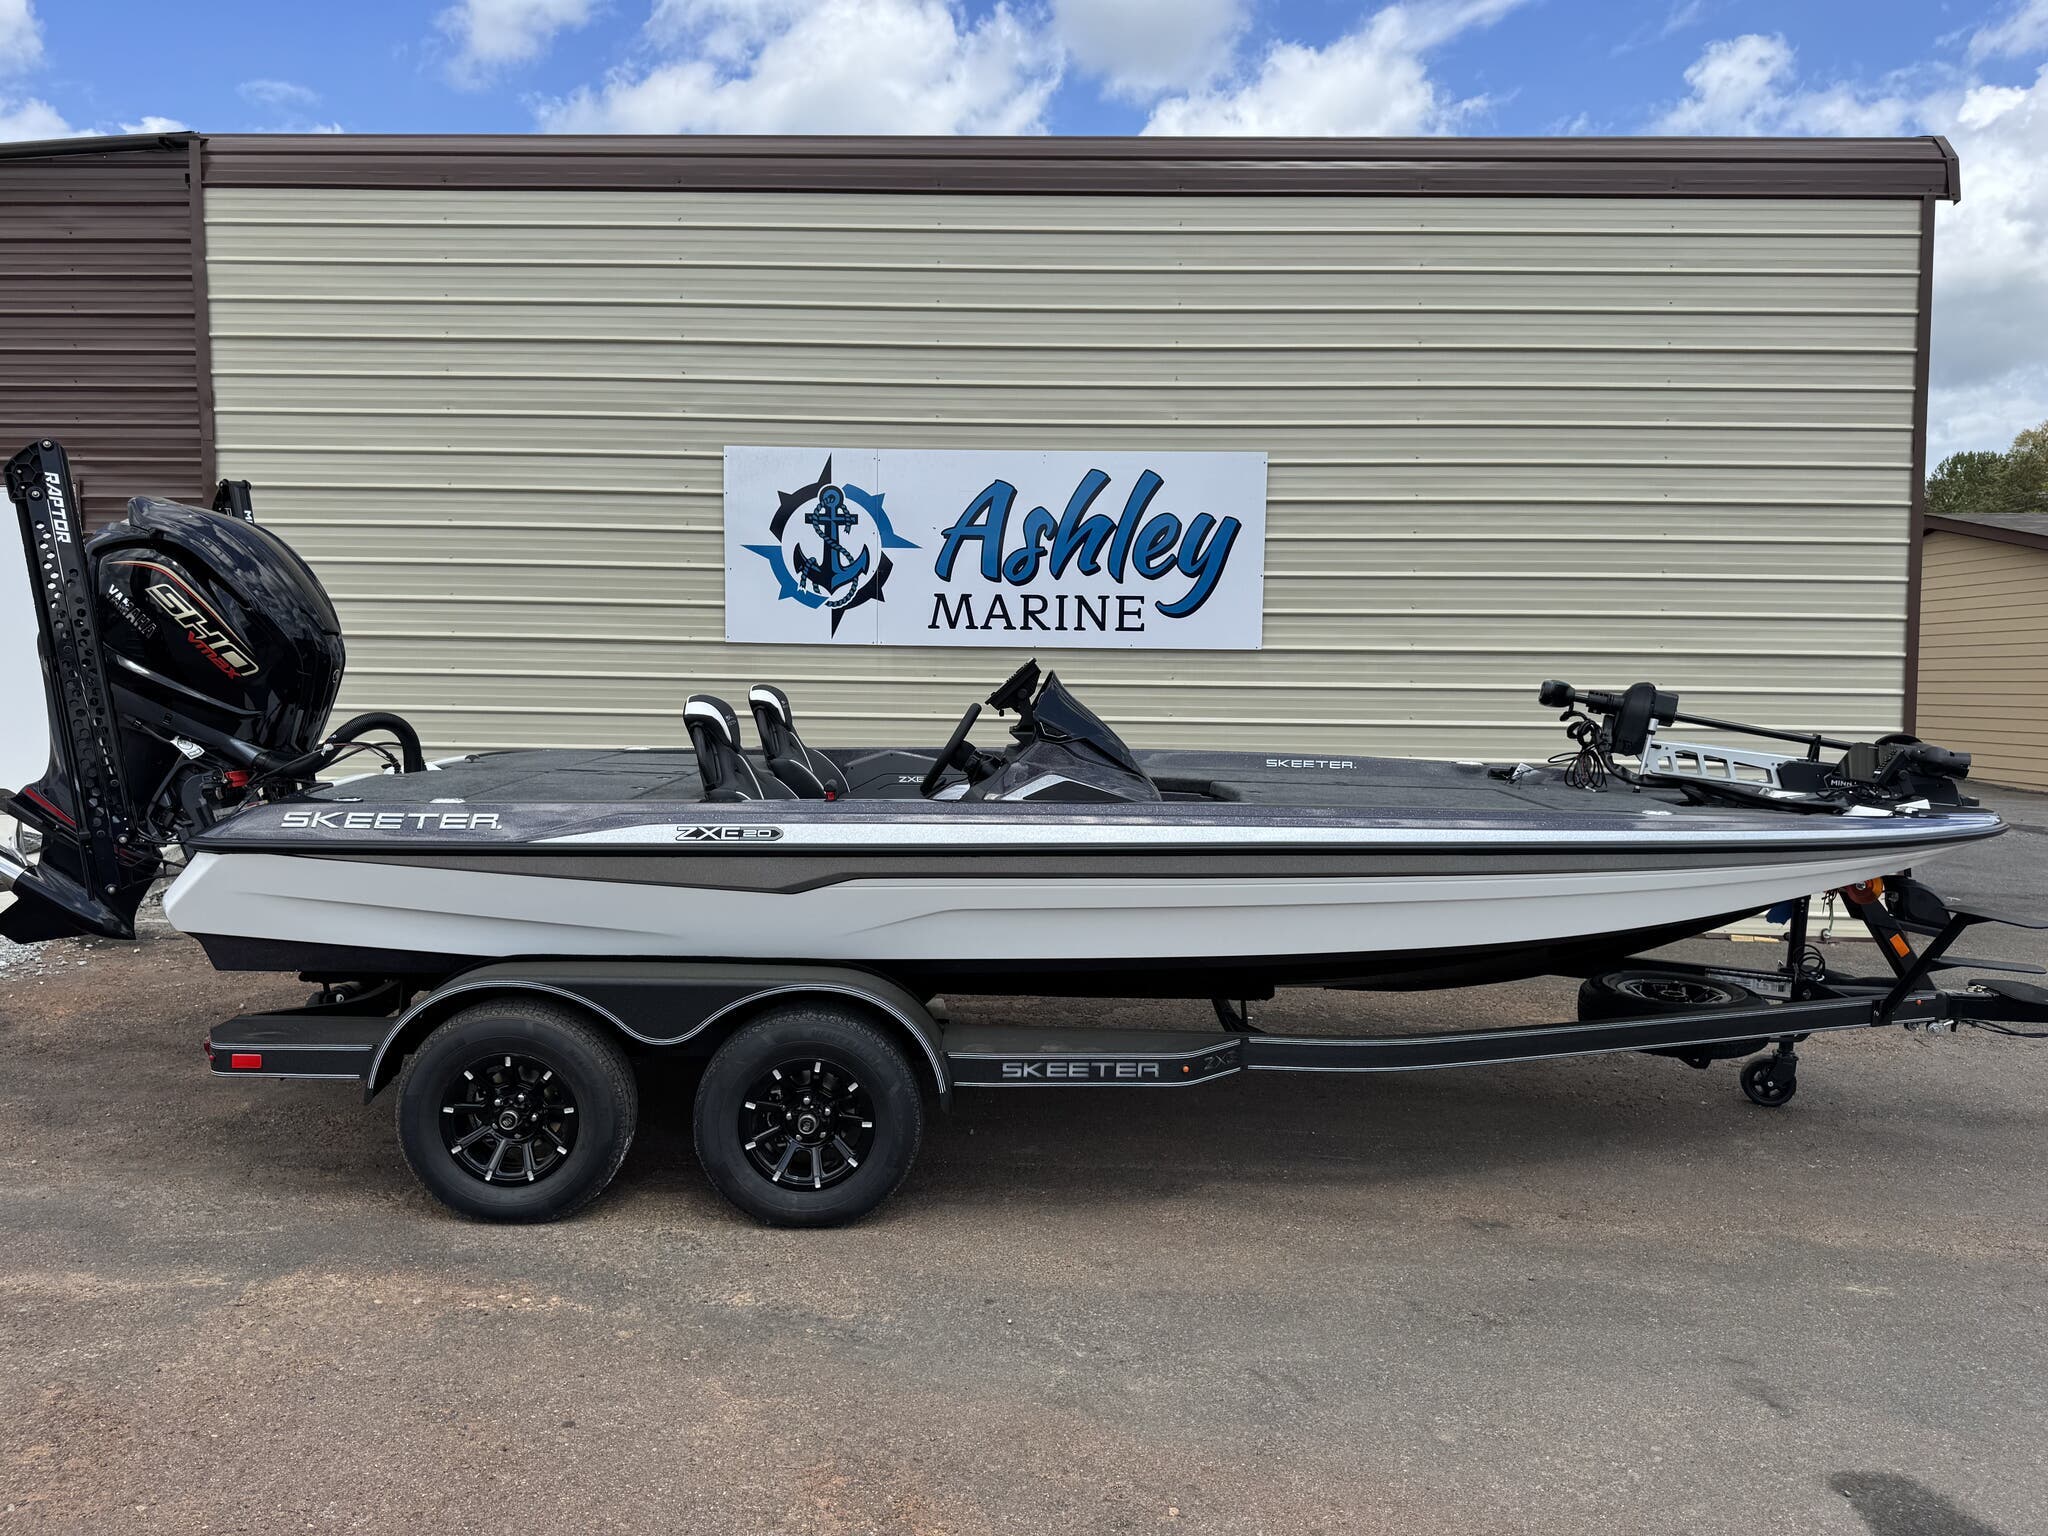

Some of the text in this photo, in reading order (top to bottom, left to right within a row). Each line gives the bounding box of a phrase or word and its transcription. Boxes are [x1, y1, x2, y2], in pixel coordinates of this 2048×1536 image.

[44, 472, 72, 543] RAPTOR
[934, 468, 1242, 618] Ashley
[105, 584, 157, 639] YAMAHA
[145, 583, 259, 677] SHO
[927, 593, 1145, 631] MARINE
[1266, 759, 1353, 769] SKEETER
[281, 811, 500, 829] SKEETER
[1002, 1062, 1160, 1079] SKEETER
